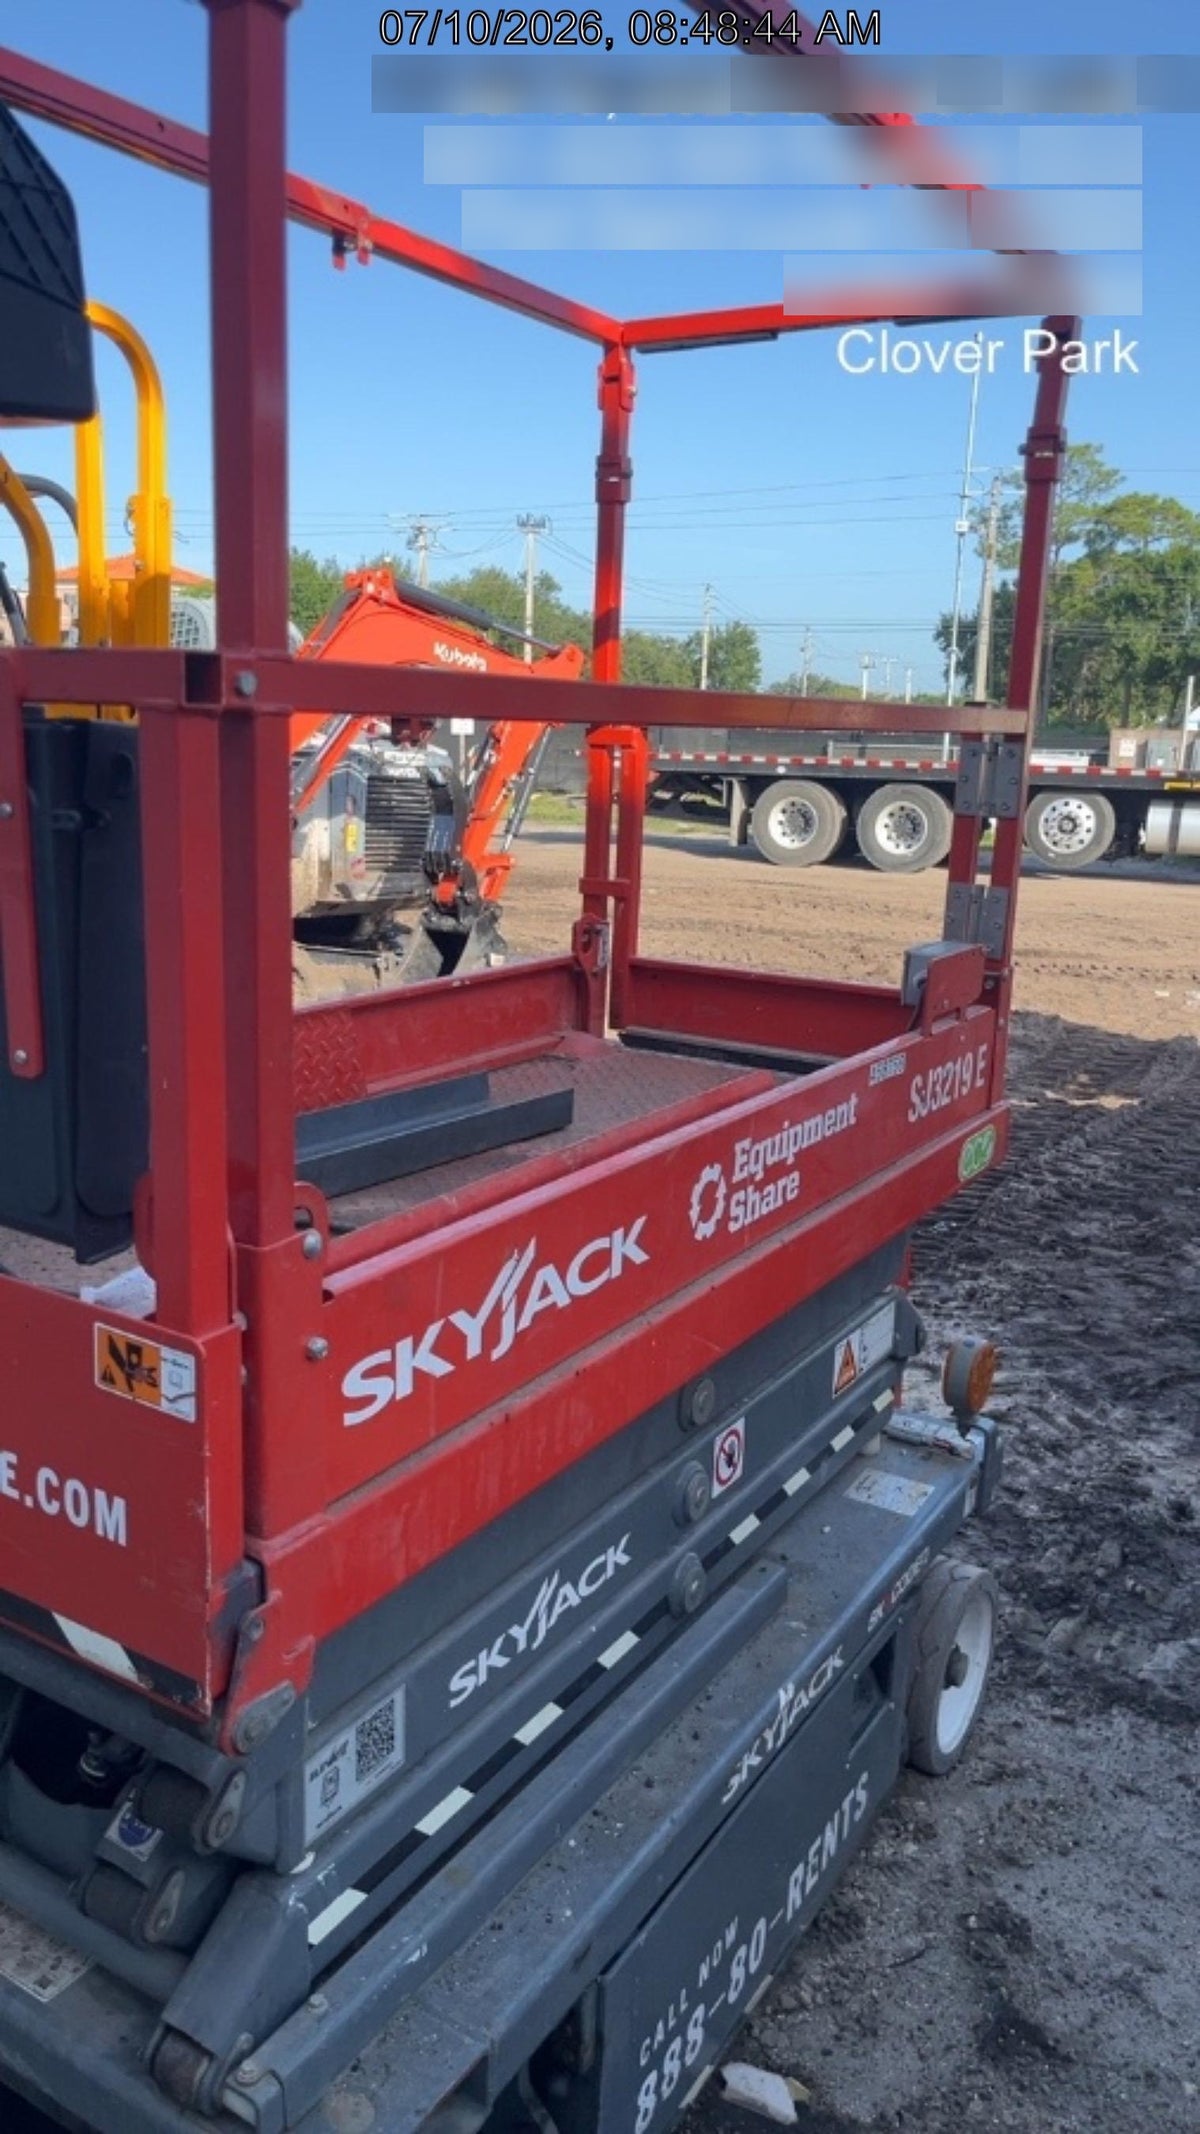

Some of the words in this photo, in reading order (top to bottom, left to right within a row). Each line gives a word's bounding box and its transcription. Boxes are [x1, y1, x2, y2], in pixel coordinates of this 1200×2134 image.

[433, 641, 488, 671] Kubota
[907, 1051, 973, 1123] SJ3219
[976, 1043, 987, 1088] E
[733, 1092, 859, 1183] Equipment
[728, 1170, 800, 1234] Share
[341, 1215, 650, 1427] SKYJACK
[448, 1531, 632, 1709] SKYJACK
[640, 1987, 689, 2067] CALL
[698, 1915, 738, 1988] NOW
